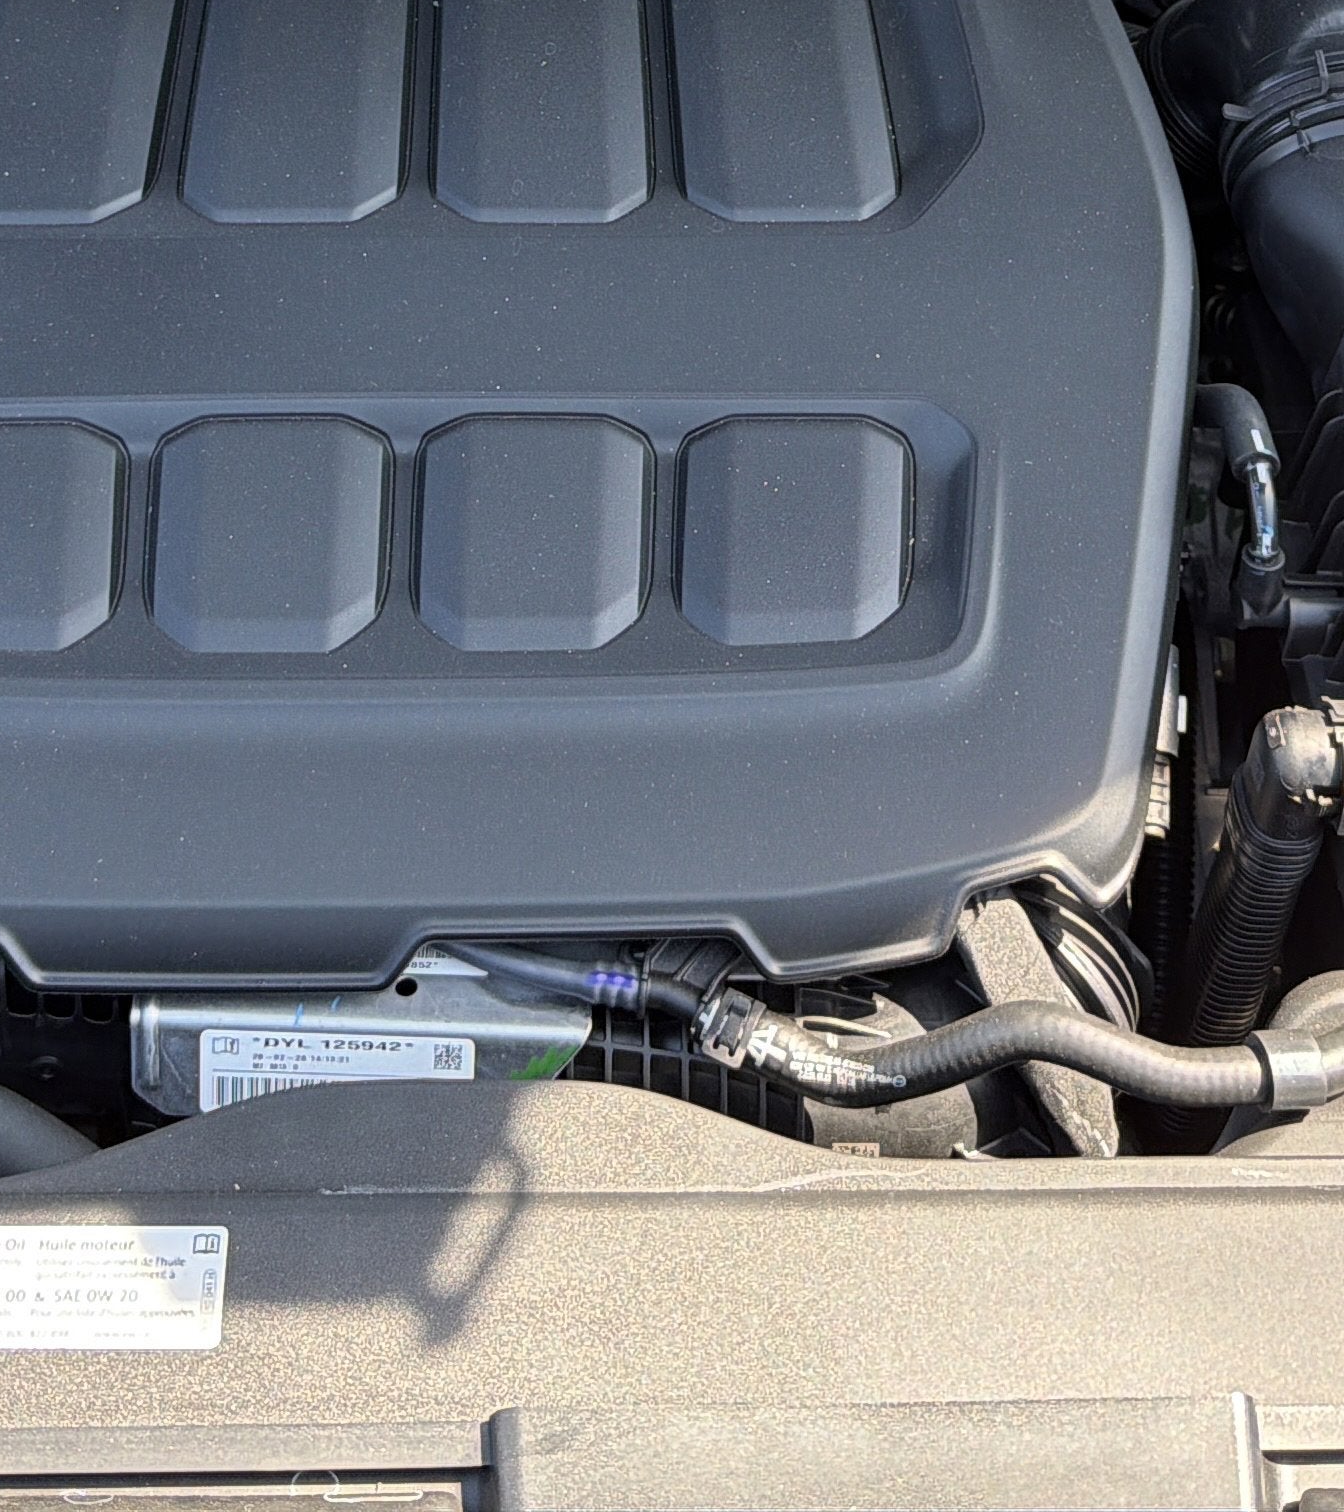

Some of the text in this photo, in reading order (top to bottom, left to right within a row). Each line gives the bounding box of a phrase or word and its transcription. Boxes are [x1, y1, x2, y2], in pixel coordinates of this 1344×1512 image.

[5, 1238, 27, 1252] Oil
[39, 1239, 77, 1252] Huile
[80, 1239, 136, 1252] moteur
[5, 1289, 28, 1303] 00
[34, 1292, 46, 1303] &
[54, 1289, 82, 1304] SAE
